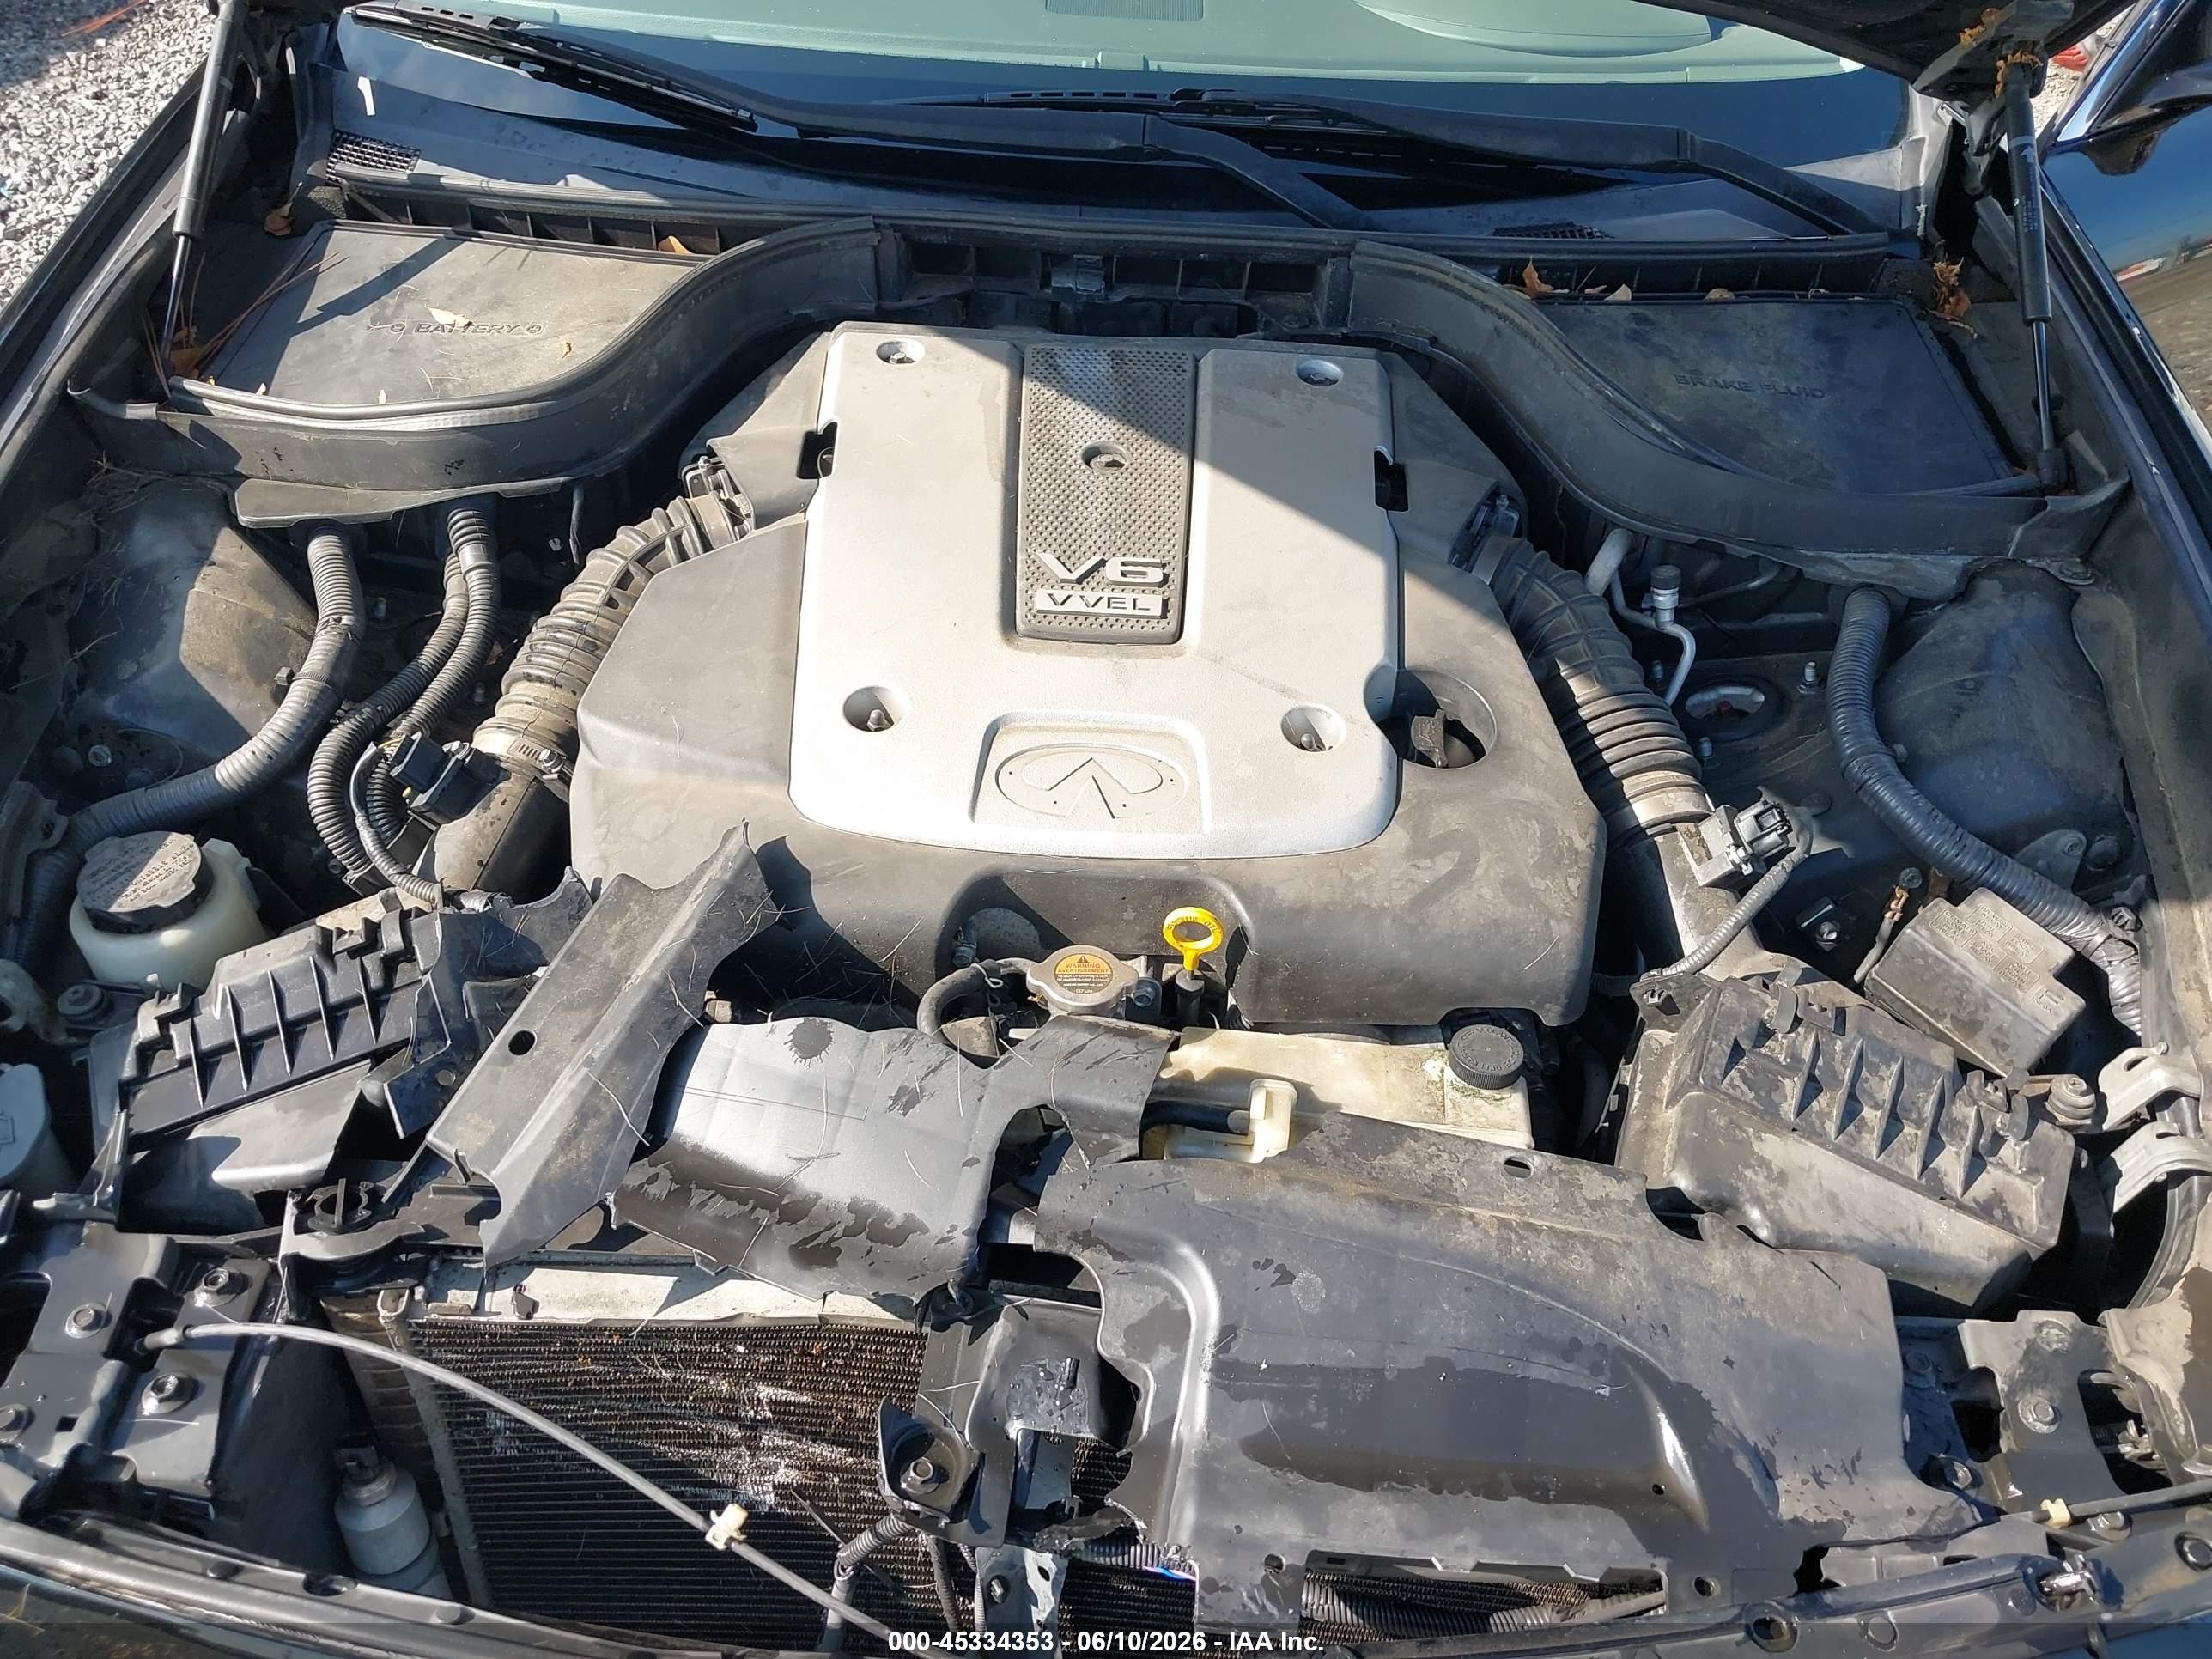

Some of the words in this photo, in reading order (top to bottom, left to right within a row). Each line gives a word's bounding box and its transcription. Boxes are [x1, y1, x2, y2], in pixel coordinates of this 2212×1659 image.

[1674, 374, 1754, 392] BRAKE
[1036, 550, 1169, 586] V6
[1048, 592, 1151, 611] VVEL
